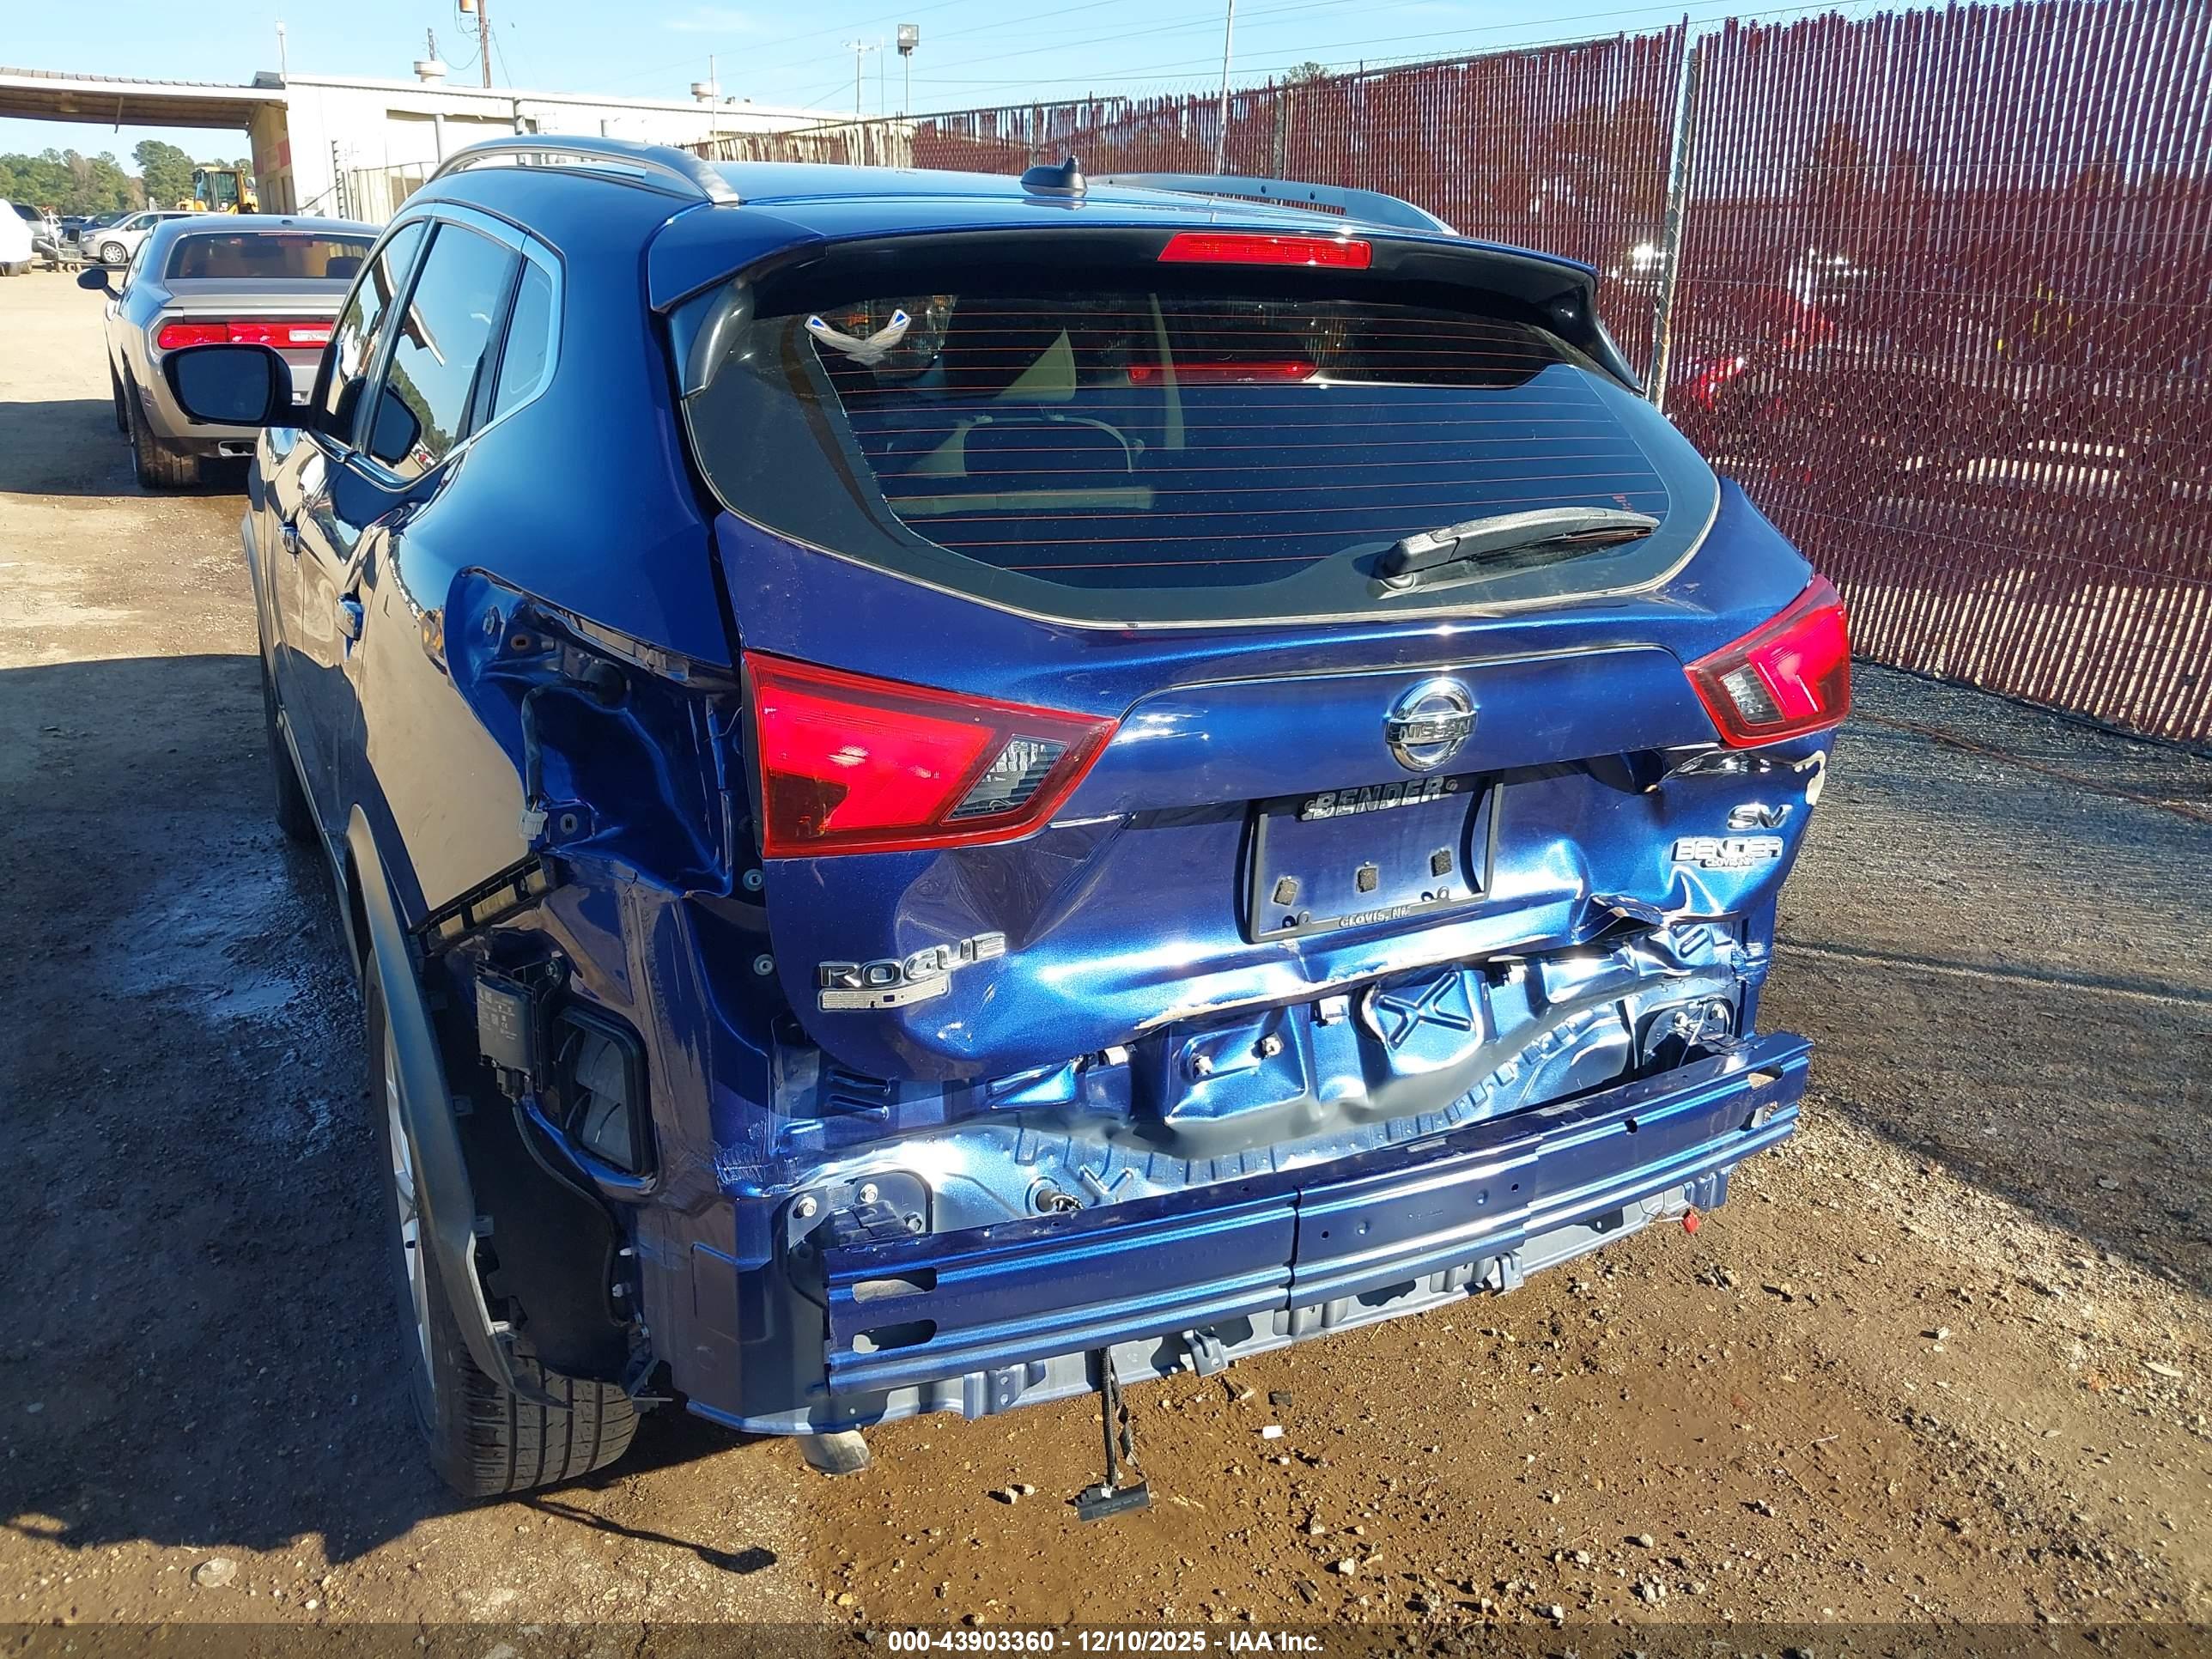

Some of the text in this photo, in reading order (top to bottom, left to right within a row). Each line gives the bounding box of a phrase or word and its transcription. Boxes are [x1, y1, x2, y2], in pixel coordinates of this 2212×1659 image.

[1399, 718, 1472, 740] NISSAN
[1312, 775, 1445, 820] BENDER
[1727, 802, 1793, 830] SV
[1671, 836, 1784, 861] BENDER
[819, 932, 1006, 988] ROGUE
